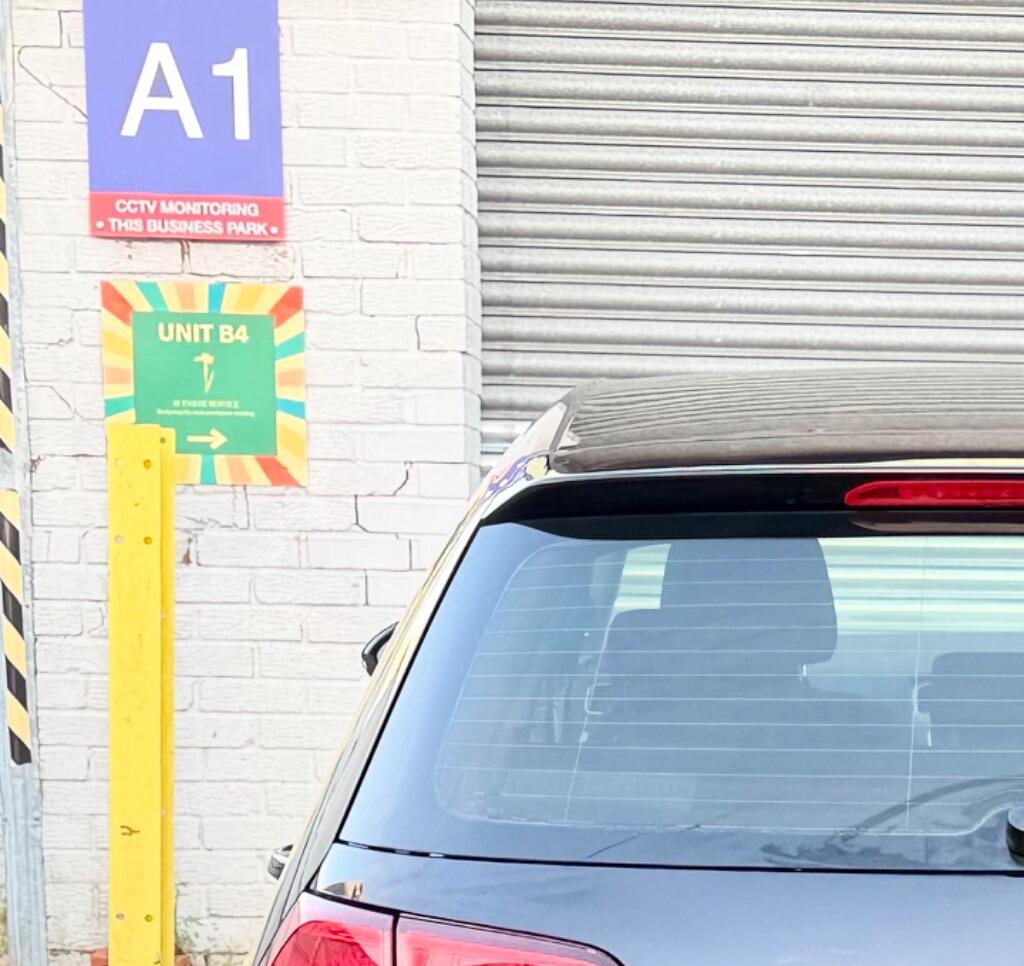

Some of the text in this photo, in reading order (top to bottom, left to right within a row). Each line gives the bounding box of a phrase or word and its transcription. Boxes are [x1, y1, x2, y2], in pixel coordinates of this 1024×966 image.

[120, 42, 250, 140] A1
[115, 199, 259, 216] CCTV MONITORING
[108, 218, 268, 235] THIS BUSINESS PARK
[158, 322, 249, 344] UNIT B4
